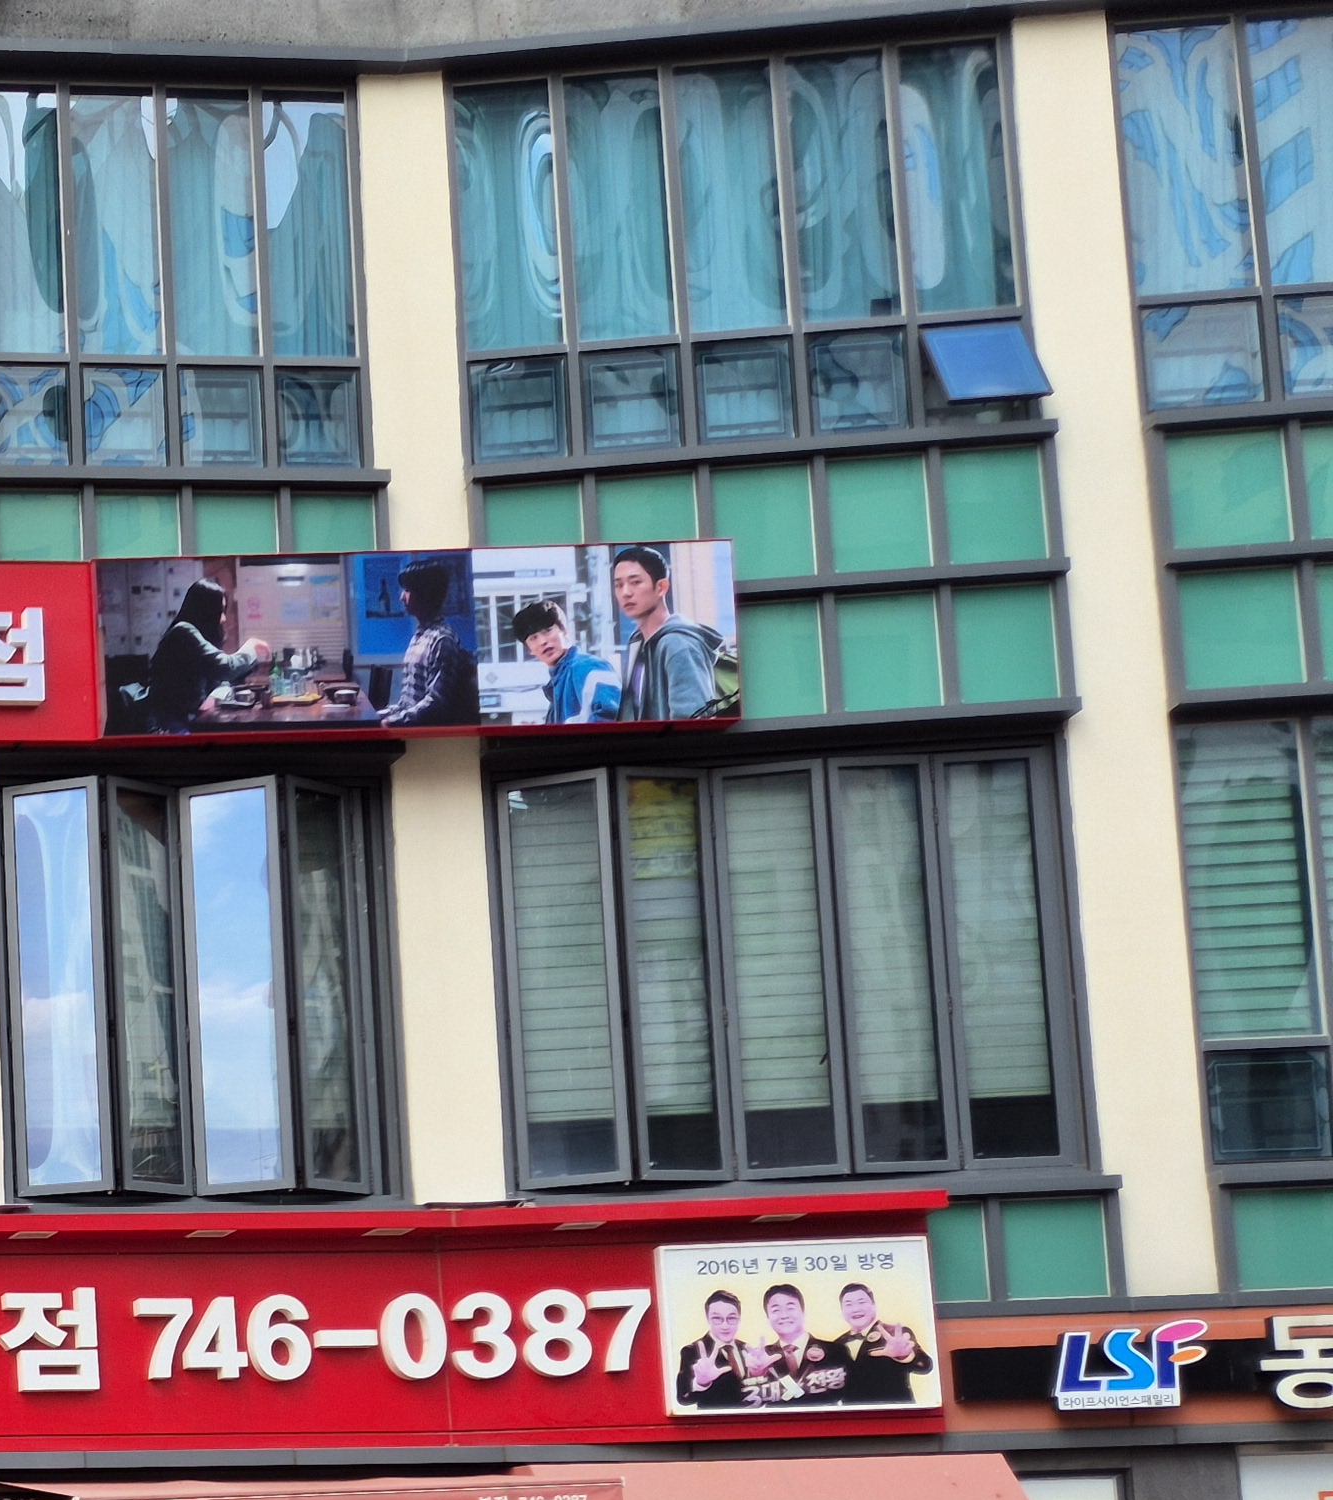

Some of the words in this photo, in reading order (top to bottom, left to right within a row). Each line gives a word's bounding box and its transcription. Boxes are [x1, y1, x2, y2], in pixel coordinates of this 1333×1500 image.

[697, 1257, 759, 1276] 2016년
[766, 1256, 798, 1274] 7월
[804, 1254, 848, 1272] 30일
[858, 1252, 894, 1271] 방영
[134, 1287, 652, 1386] 746-0387
[1058, 1319, 1209, 1392] LSF
[1062, 1394, 1175, 1408] 라이프사이언스패밀리
